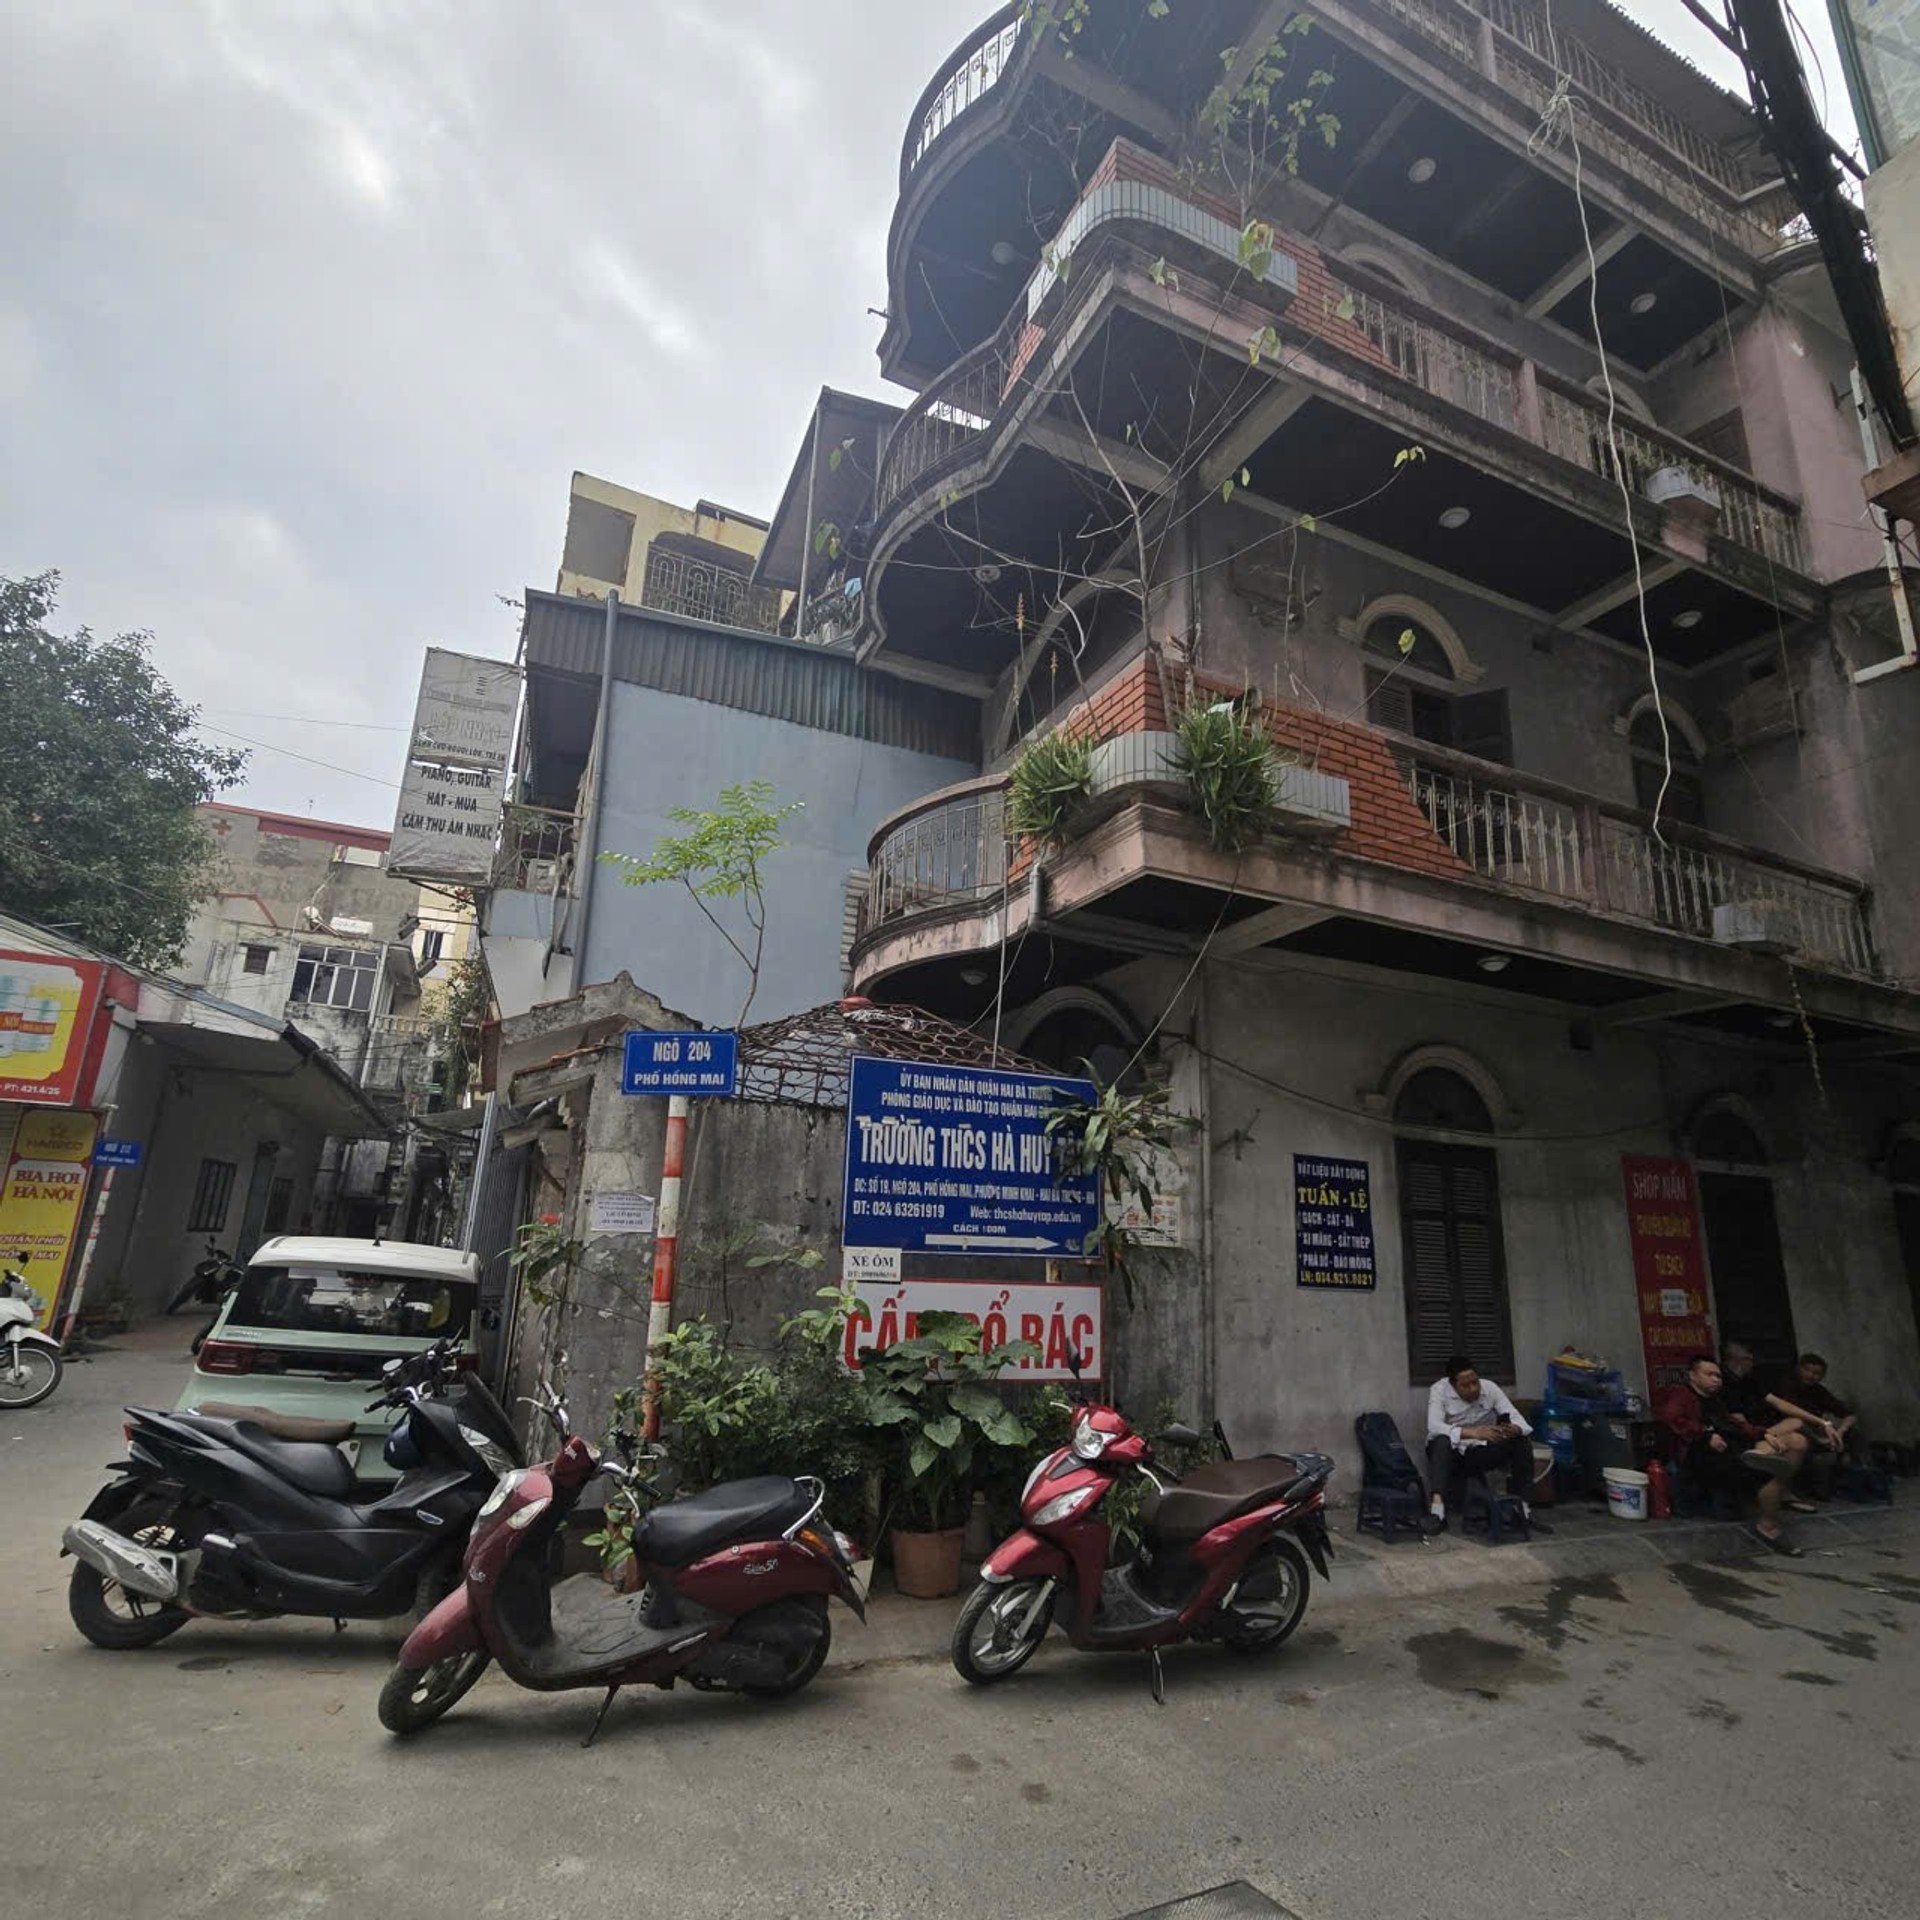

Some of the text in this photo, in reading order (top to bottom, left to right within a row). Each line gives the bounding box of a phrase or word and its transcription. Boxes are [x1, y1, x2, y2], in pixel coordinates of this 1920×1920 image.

[457, 772, 492, 789] GUITAR
[653, 1038, 711, 1062] NGÕ 204
[634, 1070, 659, 1085] PHỐ
[700, 1073, 725, 1085] MAI
[914, 1074, 931, 1090] BAN
[932, 1074, 957, 1092] NHÂN
[959, 1076, 975, 1094] DÂN
[977, 1078, 999, 1099] QUẬN
[1000, 1083, 1014, 1098] HAI
[1016, 1080, 1026, 1099] BÀ
[881, 1088, 911, 1107] PHÒNG
[913, 1091, 933, 1110] GIÁO
[953, 1095, 964, 1112] VÀ
[966, 1096, 983, 1113] ĐÀO
[984, 1101, 999, 1118] TẠO
[1001, 1100, 1022, 1120] QUẬN
[1024, 1104, 1037, 1119] HAI
[856, 1115, 935, 1167] TRƯỜNG
[941, 1126, 986, 1171] THCS
[992, 1124, 1015, 1172] HÀ
[1020, 1133, 1051, 1174] HUY
[16, 1170, 43, 1183] BIA
[1632, 1172, 1660, 1199] SHOP
[12, 1184, 76, 1203] HÀ NỘI
[1297, 1181, 1368, 1213] TUẤN LỆ
[853, 1200, 870, 1215] ĐT:
[873, 1201, 892, 1216] 024
[894, 1202, 945, 1218] 63261919
[970, 1204, 992, 1219] Web:
[953, 1222, 979, 1234] CÁCH
[852, 1253, 894, 1268] XE ÔM
[1021, 1302, 1094, 1370] RÁC
